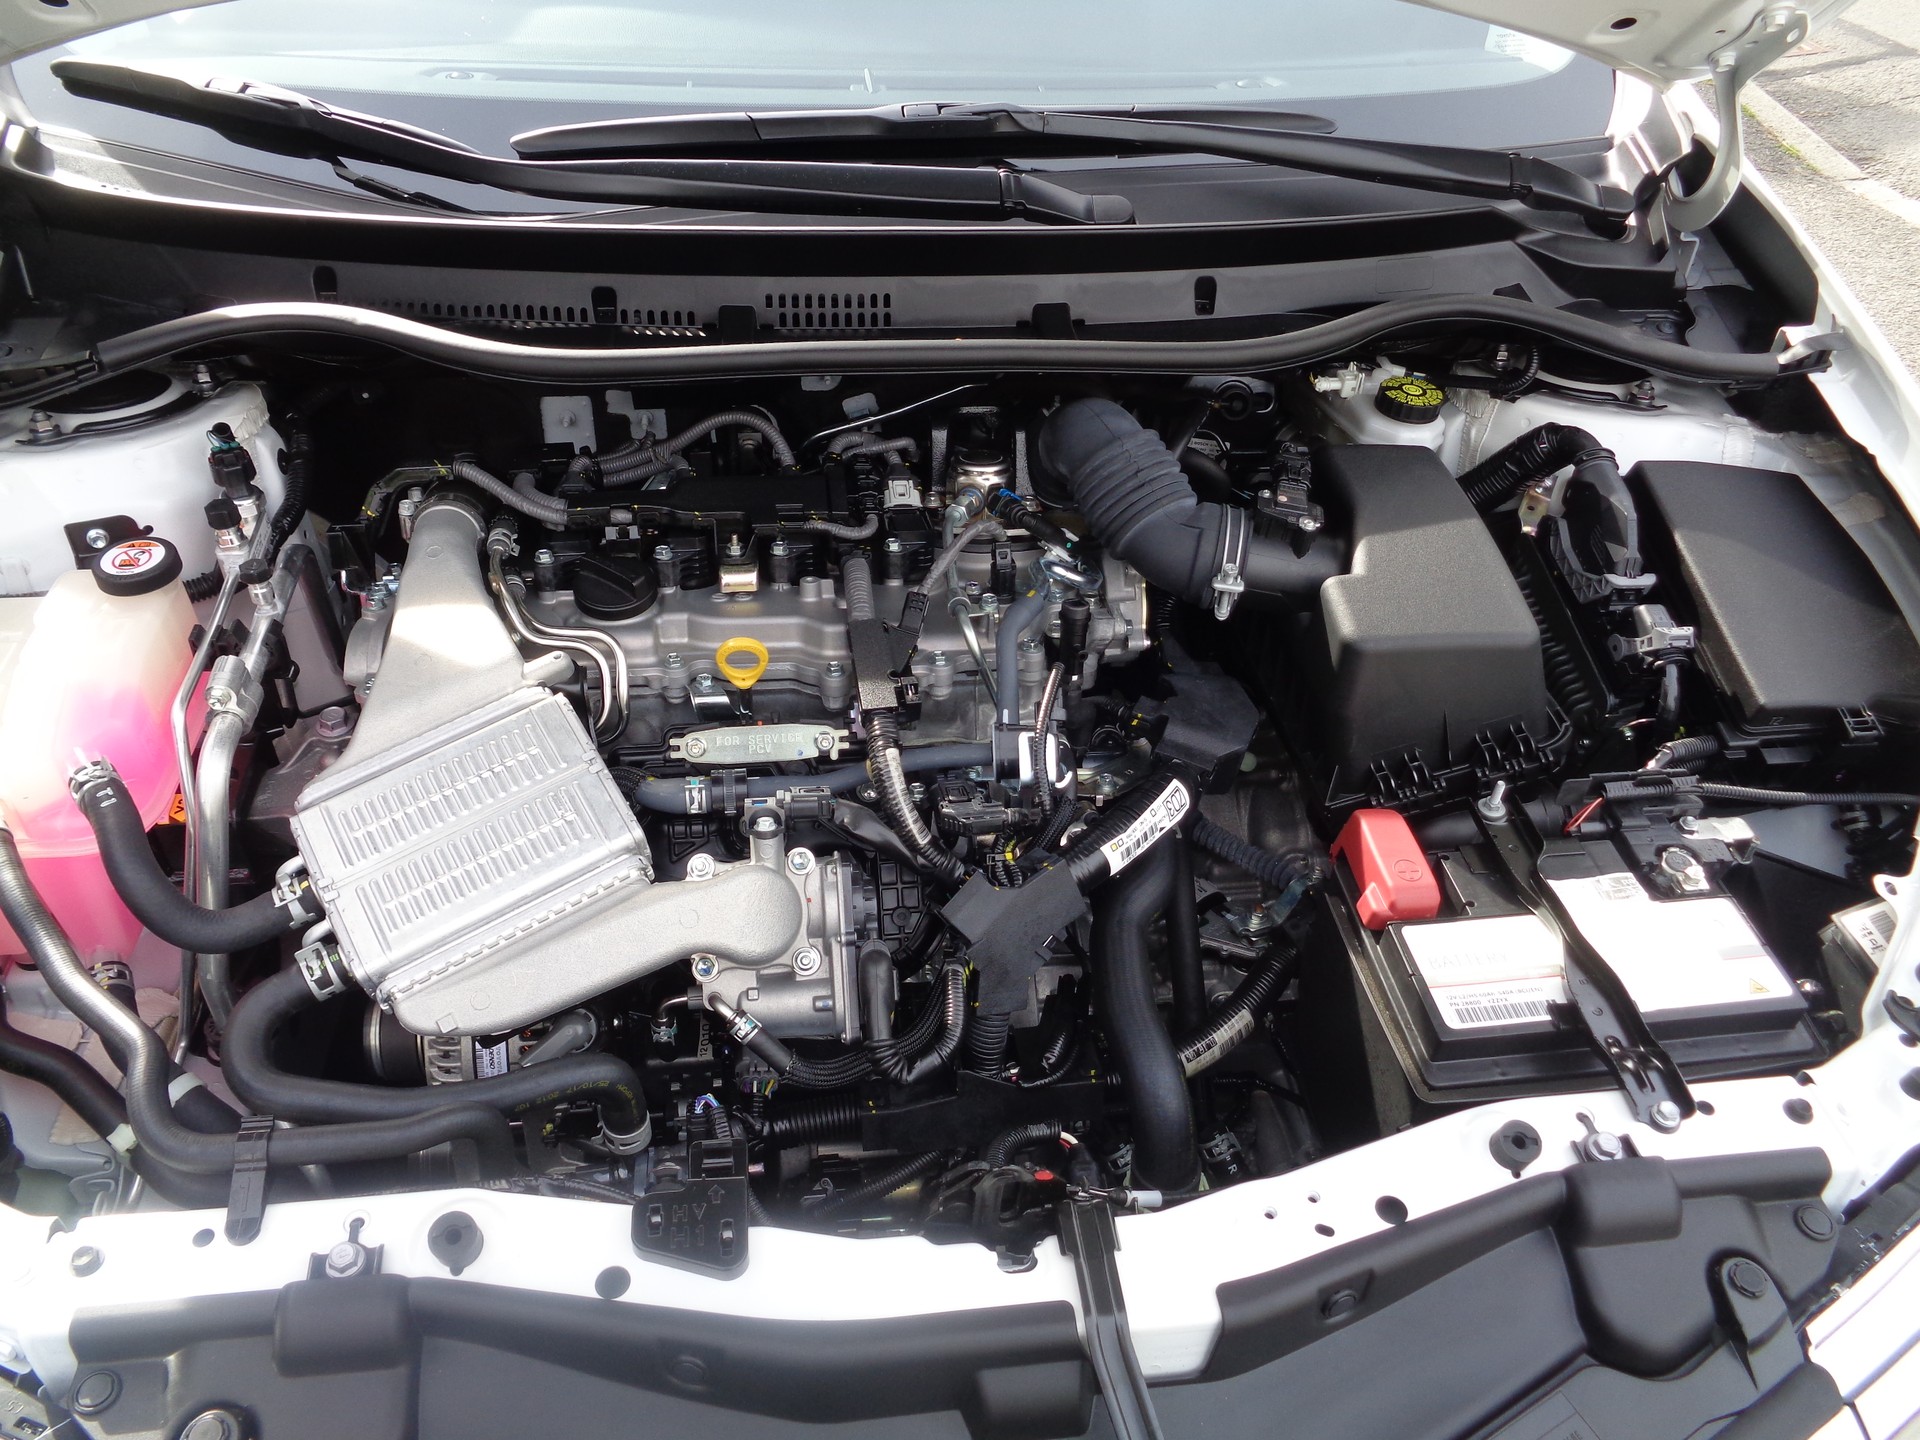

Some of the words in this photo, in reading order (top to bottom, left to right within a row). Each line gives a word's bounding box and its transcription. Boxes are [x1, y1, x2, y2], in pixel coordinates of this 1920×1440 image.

[716, 736, 740, 747] FOR
[748, 732, 804, 745] SERVICE
[748, 743, 772, 754] PCV
[488, 1048, 496, 1070] DENSO
